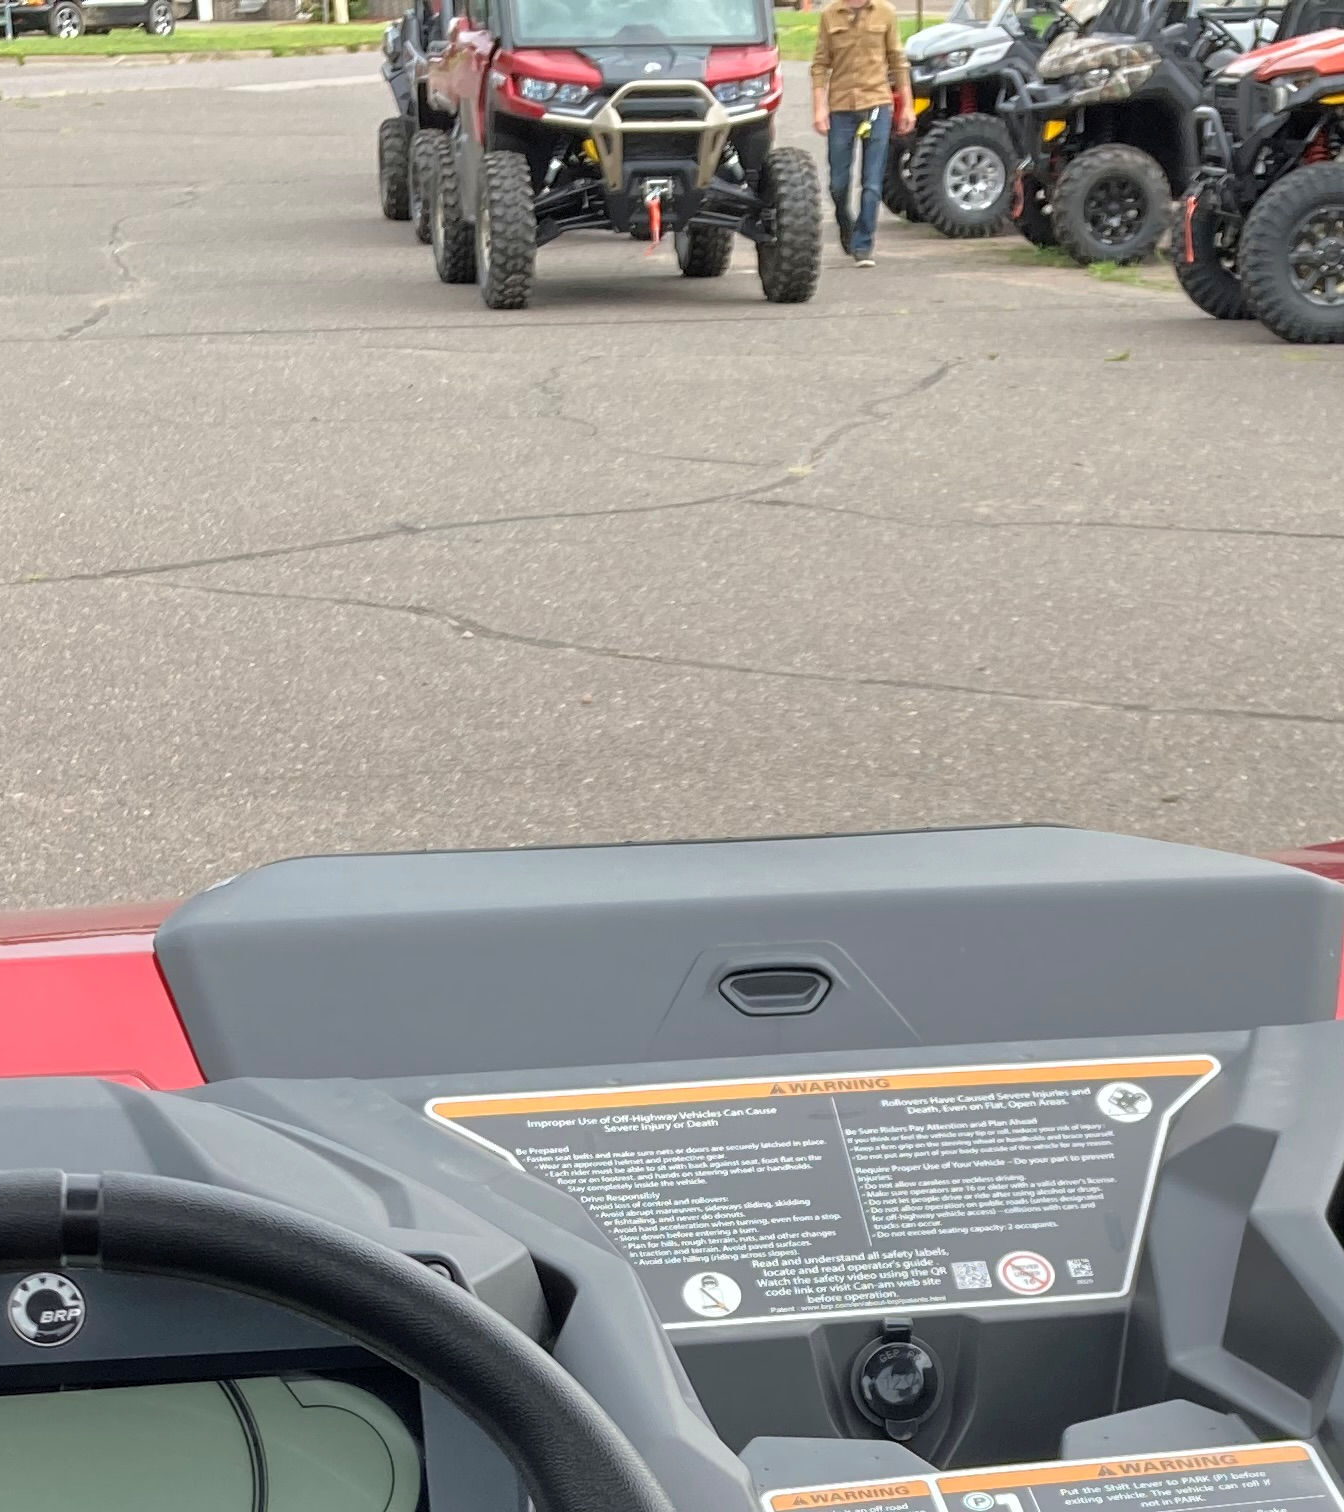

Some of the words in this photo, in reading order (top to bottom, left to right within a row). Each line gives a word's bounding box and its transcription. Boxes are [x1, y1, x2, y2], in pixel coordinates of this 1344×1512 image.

[789, 1079, 890, 1094] WARNING
[526, 1119, 576, 1128] Improper
[577, 1117, 597, 1125] Use
[599, 1115, 610, 1124] of
[611, 1113, 678, 1123] Off-Highway
[678, 1109, 722, 1119] Vehicles
[722, 1108, 744, 1116] Can
[744, 1107, 777, 1115] Cause
[603, 1124, 639, 1132] Severe
[640, 1122, 671, 1131] Injury
[686, 1118, 718, 1127] Death
[751, 1257, 779, 1267] Read
[780, 1256, 801, 1266] and
[803, 1251, 865, 1264] understand
[866, 1250, 879, 1260] all
[881, 1249, 913, 1259] safety
[39, 1308, 82, 1324] BRP
[1118, 1454, 1240, 1476] WARNING
[1103, 1482, 1130, 1491] Shift
[1132, 1480, 1162, 1489] Lever
[1180, 1475, 1210, 1484] PARK
[1230, 1471, 1266, 1479] before
[810, 1485, 910, 1505] WARNING
[1064, 1496, 1103, 1505] exiting
[1175, 1484, 1214, 1494] vehicle
[1241, 1479, 1259, 1488] roll
[1140, 1499, 1160, 1507] not
[1173, 1494, 1206, 1504] PARK.
